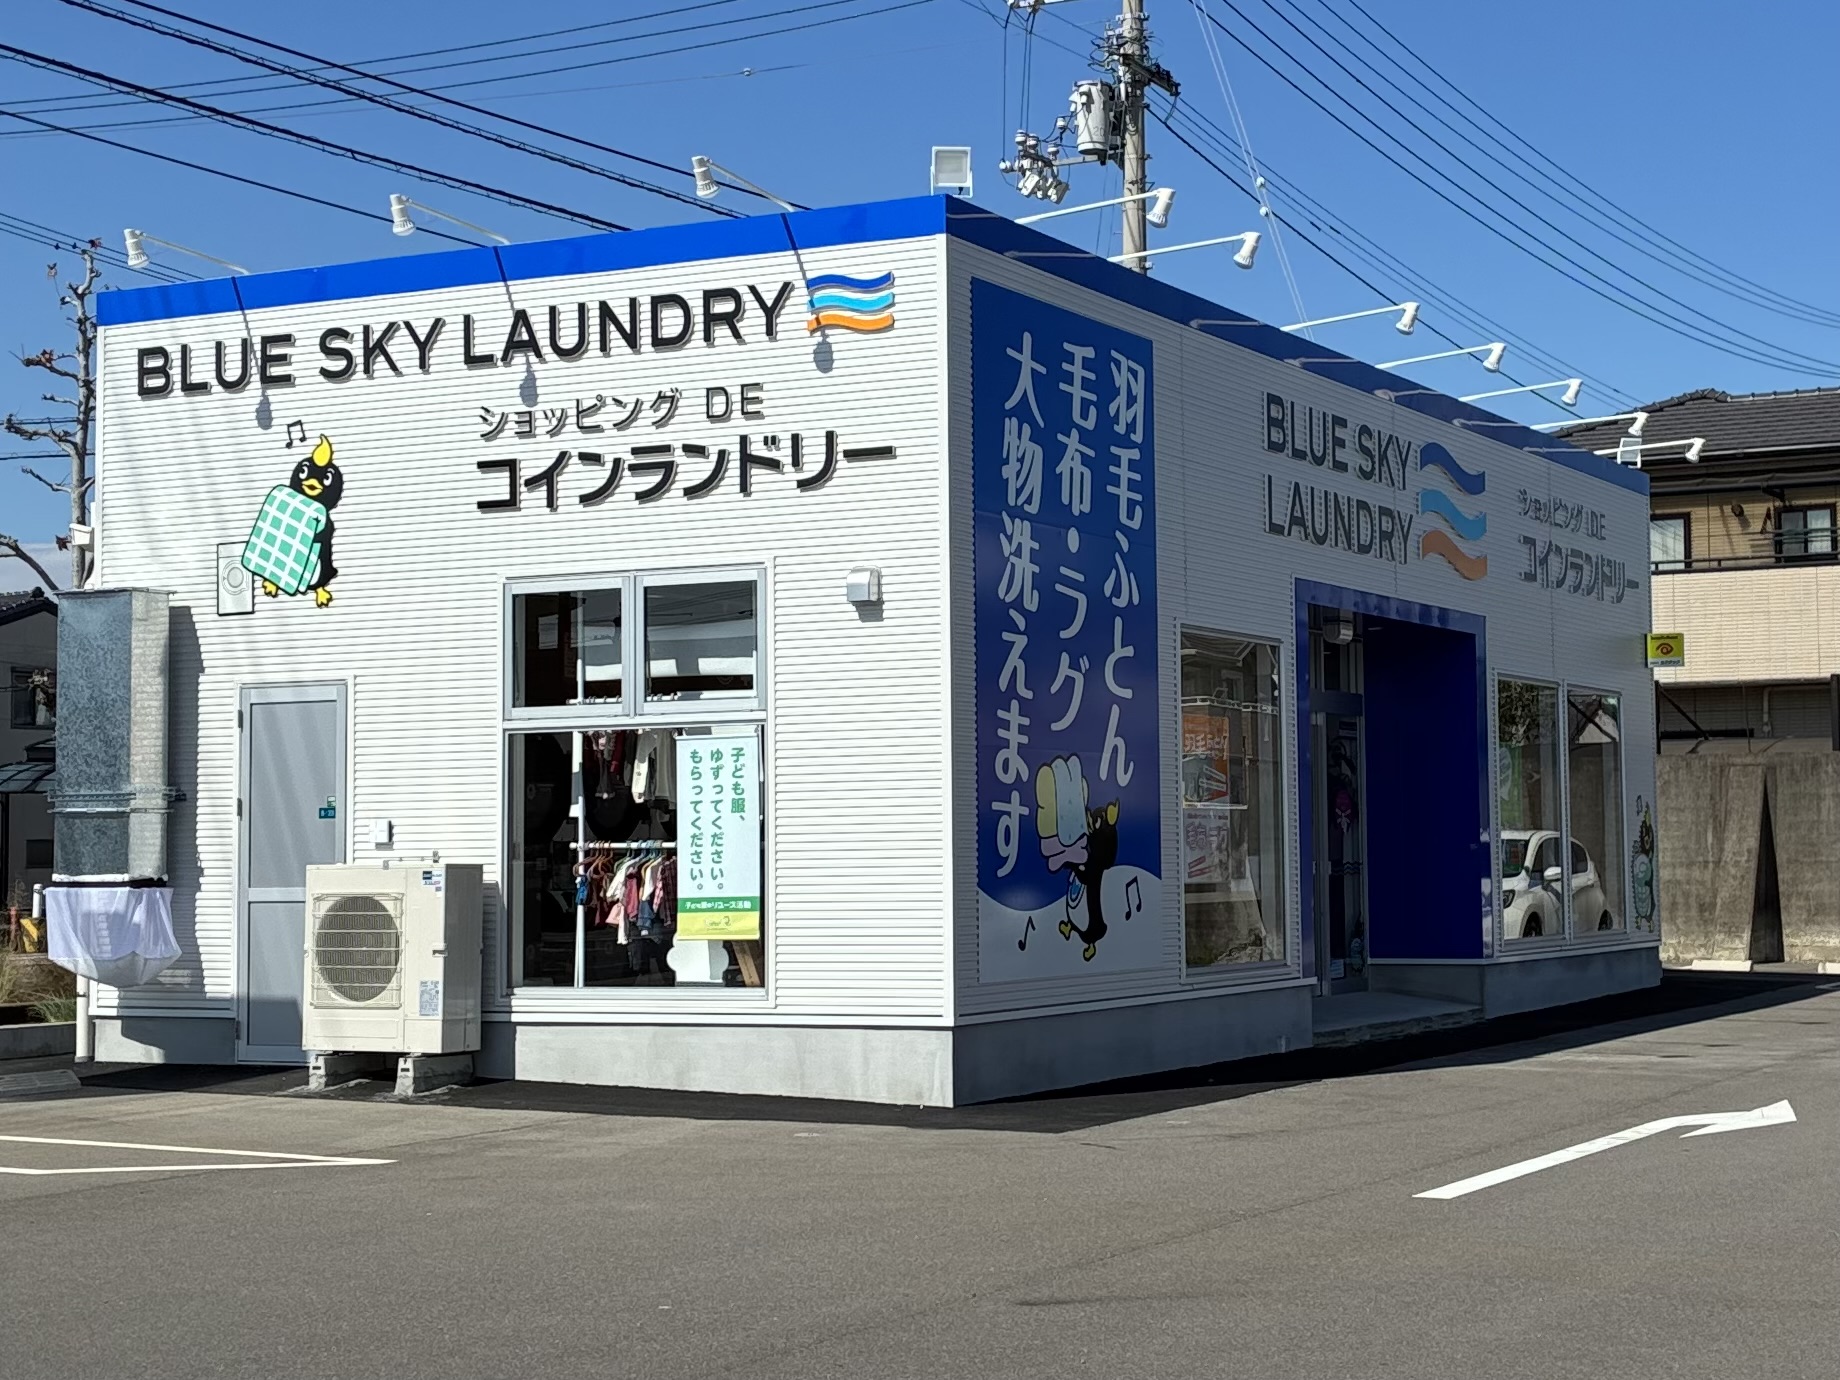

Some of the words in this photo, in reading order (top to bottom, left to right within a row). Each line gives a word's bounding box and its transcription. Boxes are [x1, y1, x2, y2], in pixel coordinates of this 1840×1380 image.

[137, 333, 296, 397] BLUE
[318, 316, 445, 380] SKY
[464, 281, 795, 366] LAUNDRY
[479, 387, 682, 440] ショッピング
[706, 383, 764, 420] DE
[1265, 392, 1349, 473] BLUE
[1355, 423, 1412, 491] SKY
[476, 430, 897, 512] コインランドリー
[1265, 475, 1414, 564] LAUNDRY
[1518, 489, 1585, 532] ショッピング
[1050, 341, 1099, 732] 毛布・ラグ
[1099, 349, 1146, 787] 羽毛ふとん
[1518, 535, 1640, 603] コインランドリー
[992, 331, 1046, 878] 大物洗えます
[690, 750, 704, 890] もらってください。
[710, 749, 724, 890] ゆずってください。
[731, 748, 745, 821] 子ども服、
